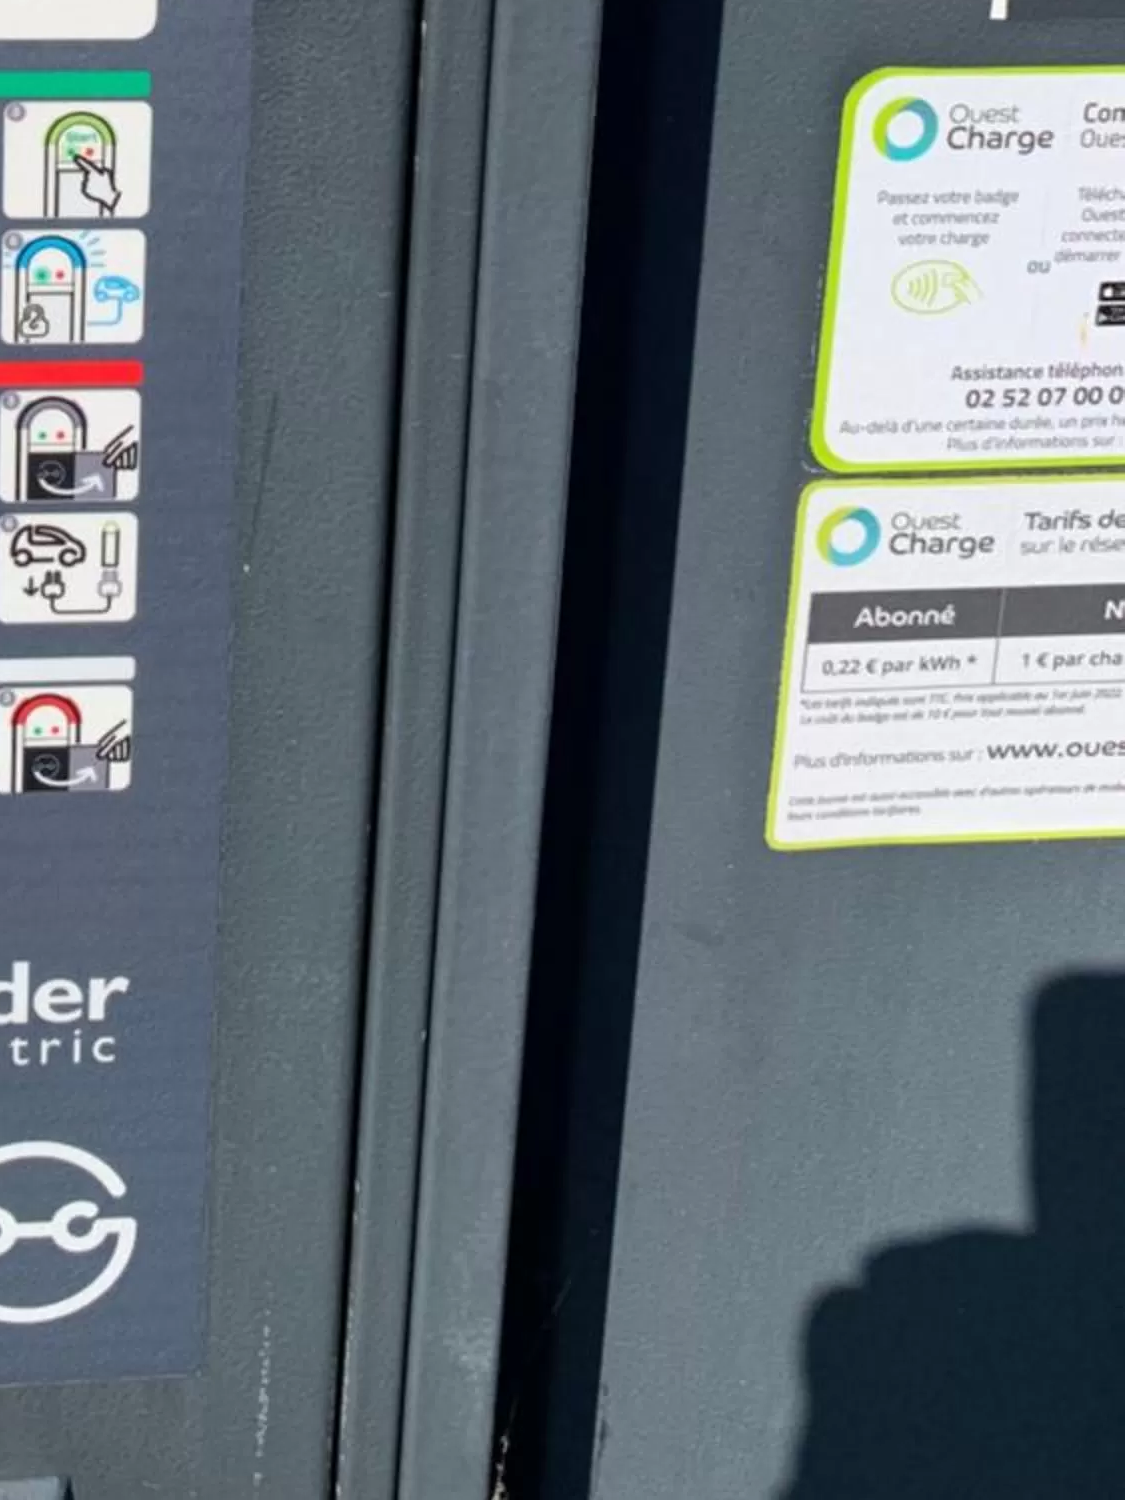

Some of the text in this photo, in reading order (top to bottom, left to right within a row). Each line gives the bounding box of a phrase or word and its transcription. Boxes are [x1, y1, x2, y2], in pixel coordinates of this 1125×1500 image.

[949, 103, 1021, 123] Ouest
[947, 126, 1054, 155] Charge
[1028, 259, 1051, 274] ou
[951, 365, 1043, 381] Assistance
[966, 388, 995, 409] 02
[1002, 387, 1031, 408] 52
[1037, 387, 1067, 407] 07
[1073, 386, 1103, 406] 00
[891, 511, 960, 531] Ouest
[1024, 510, 1092, 531] Tarifs
[889, 532, 995, 558] Charge
[1020, 541, 1055, 556] sur
[1059, 536, 1076, 554] le
[854, 605, 955, 628] Abonné
[821, 659, 861, 676] 0,22
[865, 658, 878, 674] €
[881, 659, 915, 679] par
[919, 654, 961, 671] kWh
[1036, 652, 1050, 669] €
[1052, 653, 1086, 671] par
